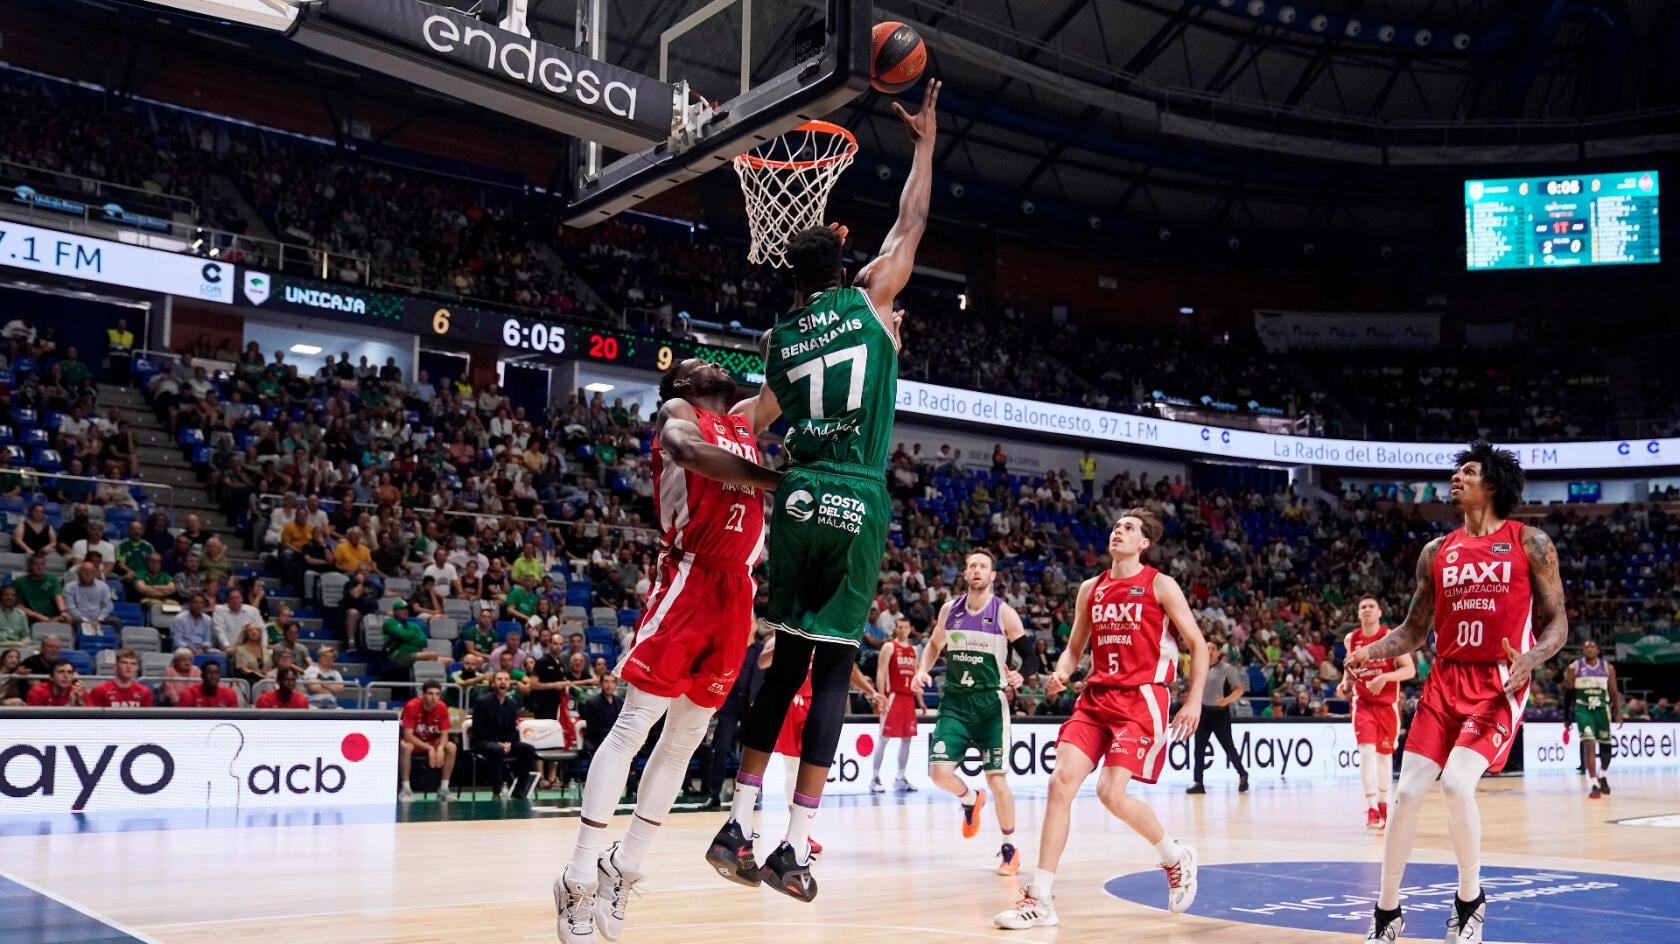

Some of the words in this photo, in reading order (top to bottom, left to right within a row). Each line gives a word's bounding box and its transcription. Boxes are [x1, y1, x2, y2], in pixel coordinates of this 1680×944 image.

[423, 15, 637, 120] endesa
[1547, 180, 1580, 196] 6:05
[56, 240, 101, 273] FM
[285, 285, 366, 315] UNICAJA
[432, 308, 451, 335] 6
[798, 309, 840, 334] SIMA
[502, 318, 566, 354] 6:05
[589, 334, 618, 360] 20
[657, 345, 673, 371] 9
[786, 343, 868, 419] 77
[919, 389, 967, 415] Radio
[972, 400, 998, 420] del
[1003, 403, 1095, 434] Baloncesto,
[1099, 416, 1132, 438] 97.1
[1138, 422, 1159, 441] FM
[1273, 440, 1290, 458] La
[1295, 442, 1340, 461] Radio
[1345, 446, 1370, 463] del
[1376, 447, 1457, 465] Balonces
[1531, 448, 1558, 465] FM
[818, 505, 841, 518] DEL
[842, 509, 863, 526] SOL
[821, 492, 867, 515] COSTA
[724, 502, 747, 533] 21
[817, 515, 860, 535] MÁLAGA
[1442, 561, 1512, 589] BAXI
[1443, 583, 1510, 599] CLIMATIZACIÓN
[1091, 602, 1143, 623] BAXI
[1456, 620, 1483, 647] 00
[952, 652, 984, 665] málaga
[1108, 652, 1119, 675] 5
[960, 670, 974, 687] 4
[928, 732, 1057, 777] ede
[1226, 730, 1313, 776] Mayo
[1538, 742, 1565, 762] acb
[1595, 728, 1656, 758] esde
[1661, 728, 1677, 757] el
[825, 753, 859, 782] cb
[1338, 749, 1361, 768] ac
[0, 743, 175, 812] ayo
[248, 757, 346, 795] acb
